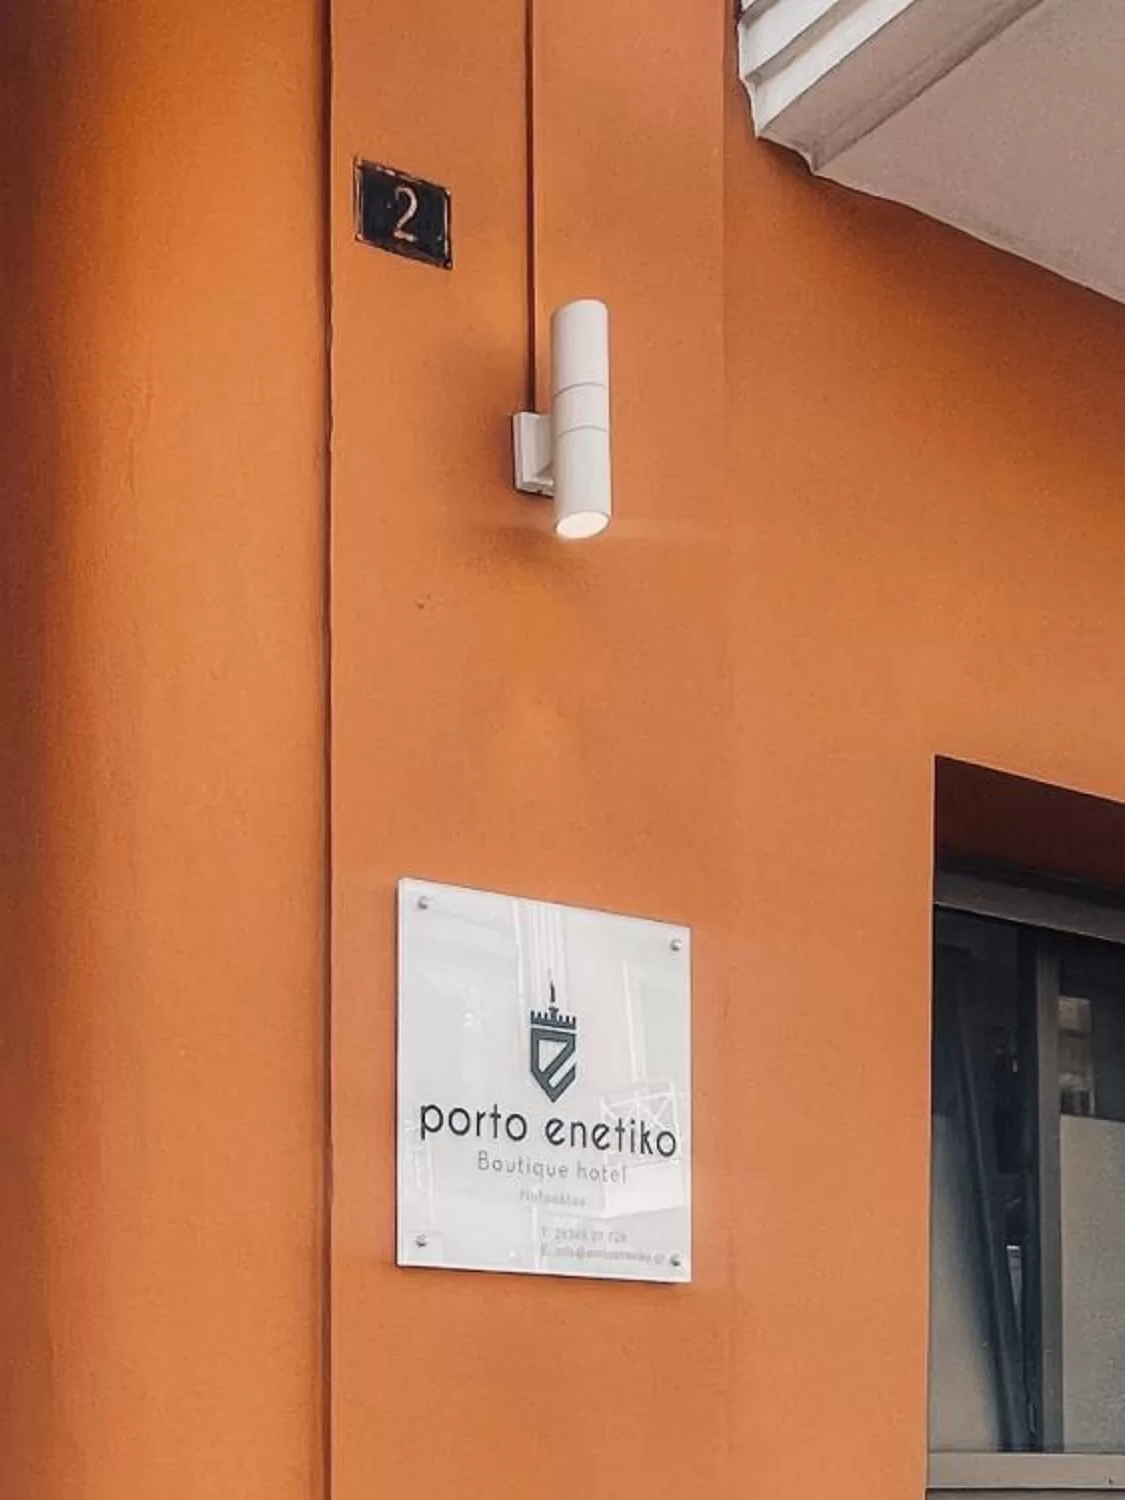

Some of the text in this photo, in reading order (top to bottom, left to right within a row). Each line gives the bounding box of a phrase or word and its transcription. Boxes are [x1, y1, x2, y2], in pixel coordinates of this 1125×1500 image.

[393, 185, 418, 242] 2
[420, 1104, 677, 1157] porto enetiko
[478, 1150, 628, 1184] Boutique hotel
